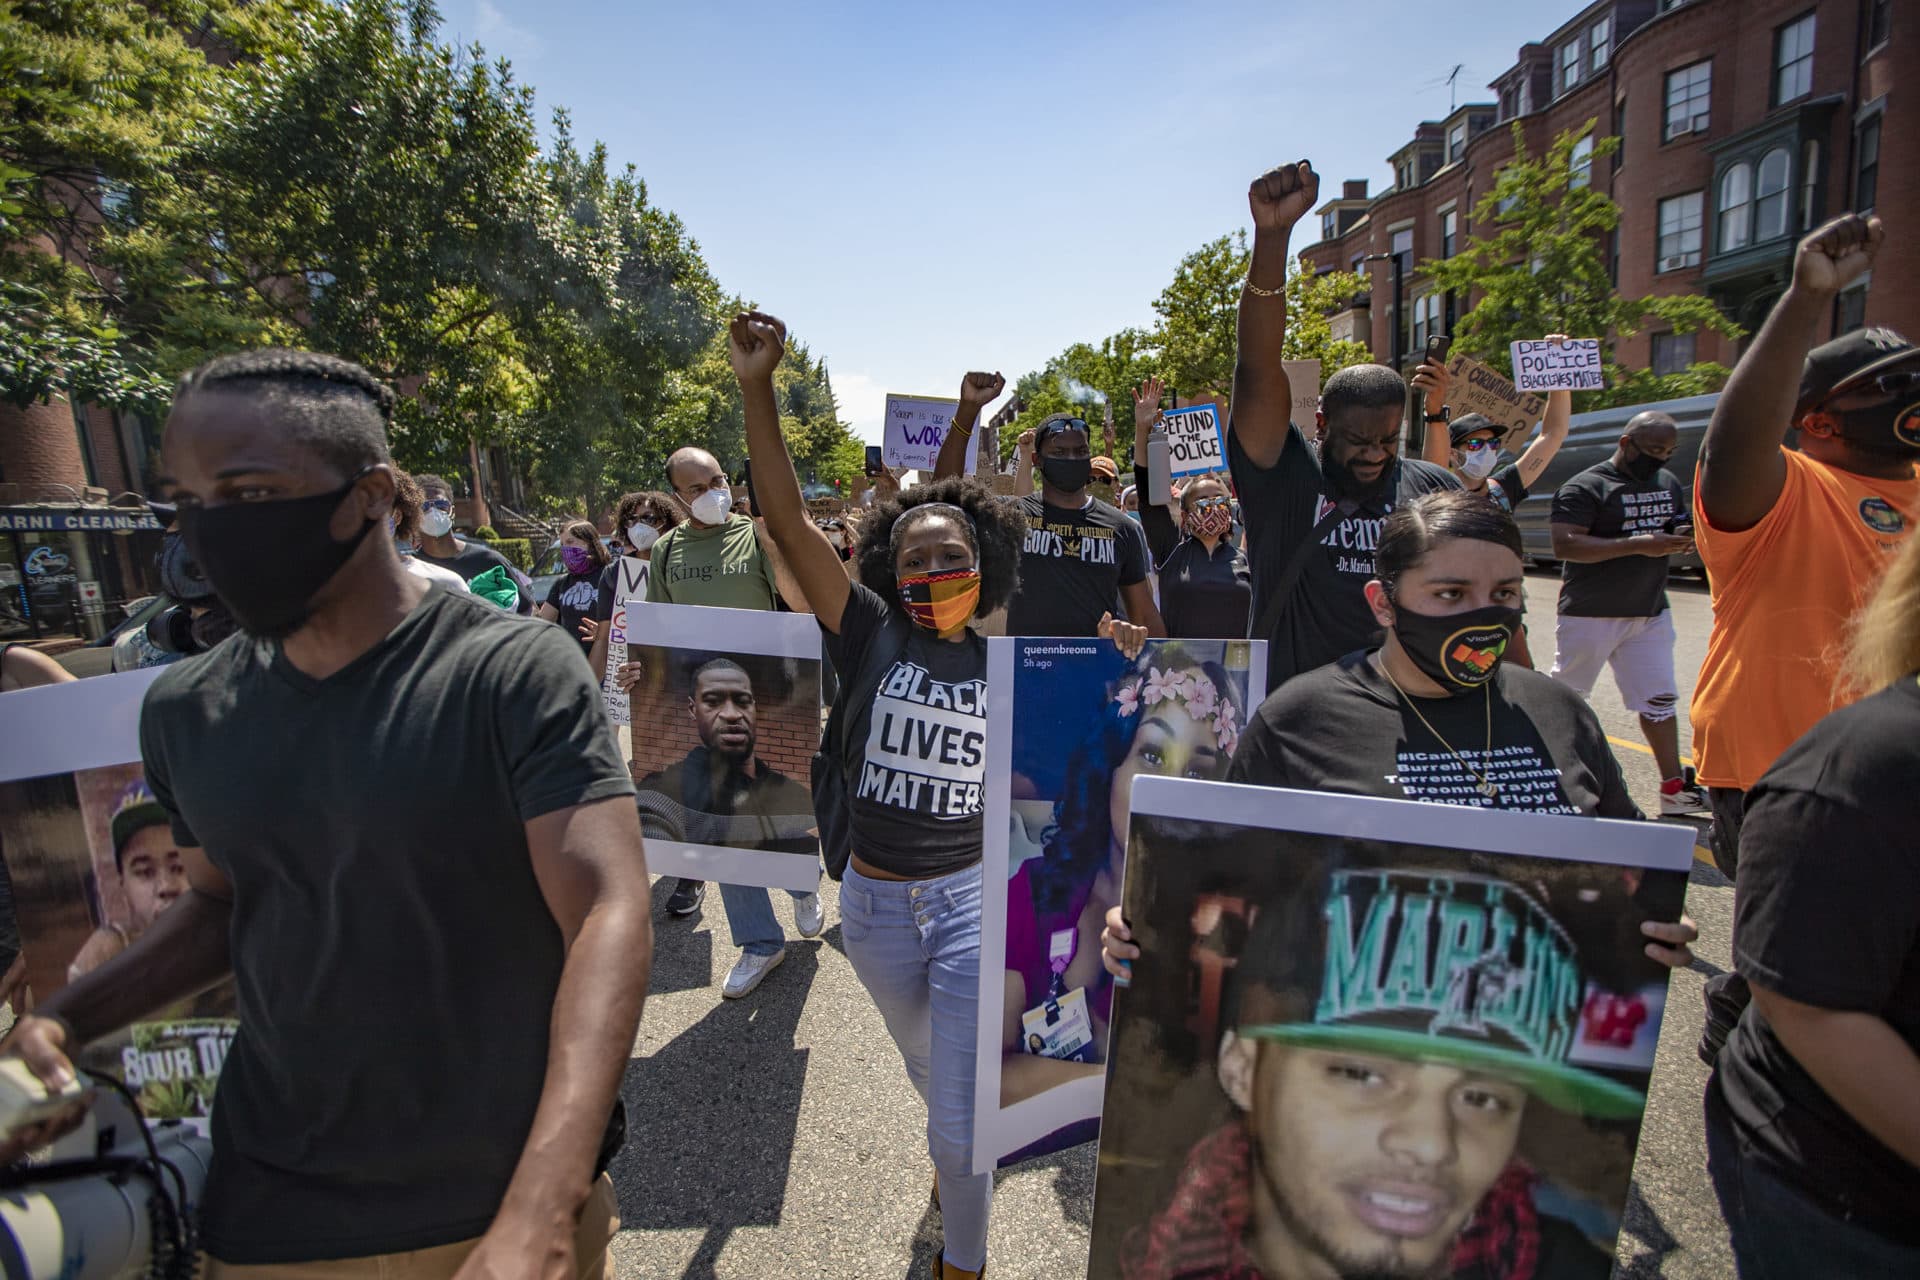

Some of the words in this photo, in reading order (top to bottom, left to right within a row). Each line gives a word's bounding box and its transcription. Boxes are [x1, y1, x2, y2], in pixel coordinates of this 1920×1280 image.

[1521, 353, 1598, 373] POLICE
[902, 423, 943, 447] WOR
[1178, 433, 1201, 443] THE
[1621, 494, 1636, 504] NO
[1637, 490, 1673, 503] JUSTICE
[1624, 506, 1639, 518] NO
[1640, 503, 1674, 517] PEACE
[64, 515, 159, 529] CLEANERS
[1023, 527, 1063, 558] GOD'S
[1081, 536, 1116, 564] PLAN
[670, 562, 713, 584] King
[1023, 644, 1097, 657] queennbreonna
[1023, 658, 1034, 668] 5h
[1036, 660, 1053, 670] ago
[884, 664, 987, 718] BLACK
[880, 712, 985, 768] LIVES
[1397, 762, 1463, 773] Burrell
[1468, 757, 1543, 772] Ramsey
[1384, 773, 1478, 785] Terrence
[1484, 768, 1563, 781] Coleman
[1496, 780, 1557, 793] Taylor
[1500, 792, 1558, 805] Floyd
